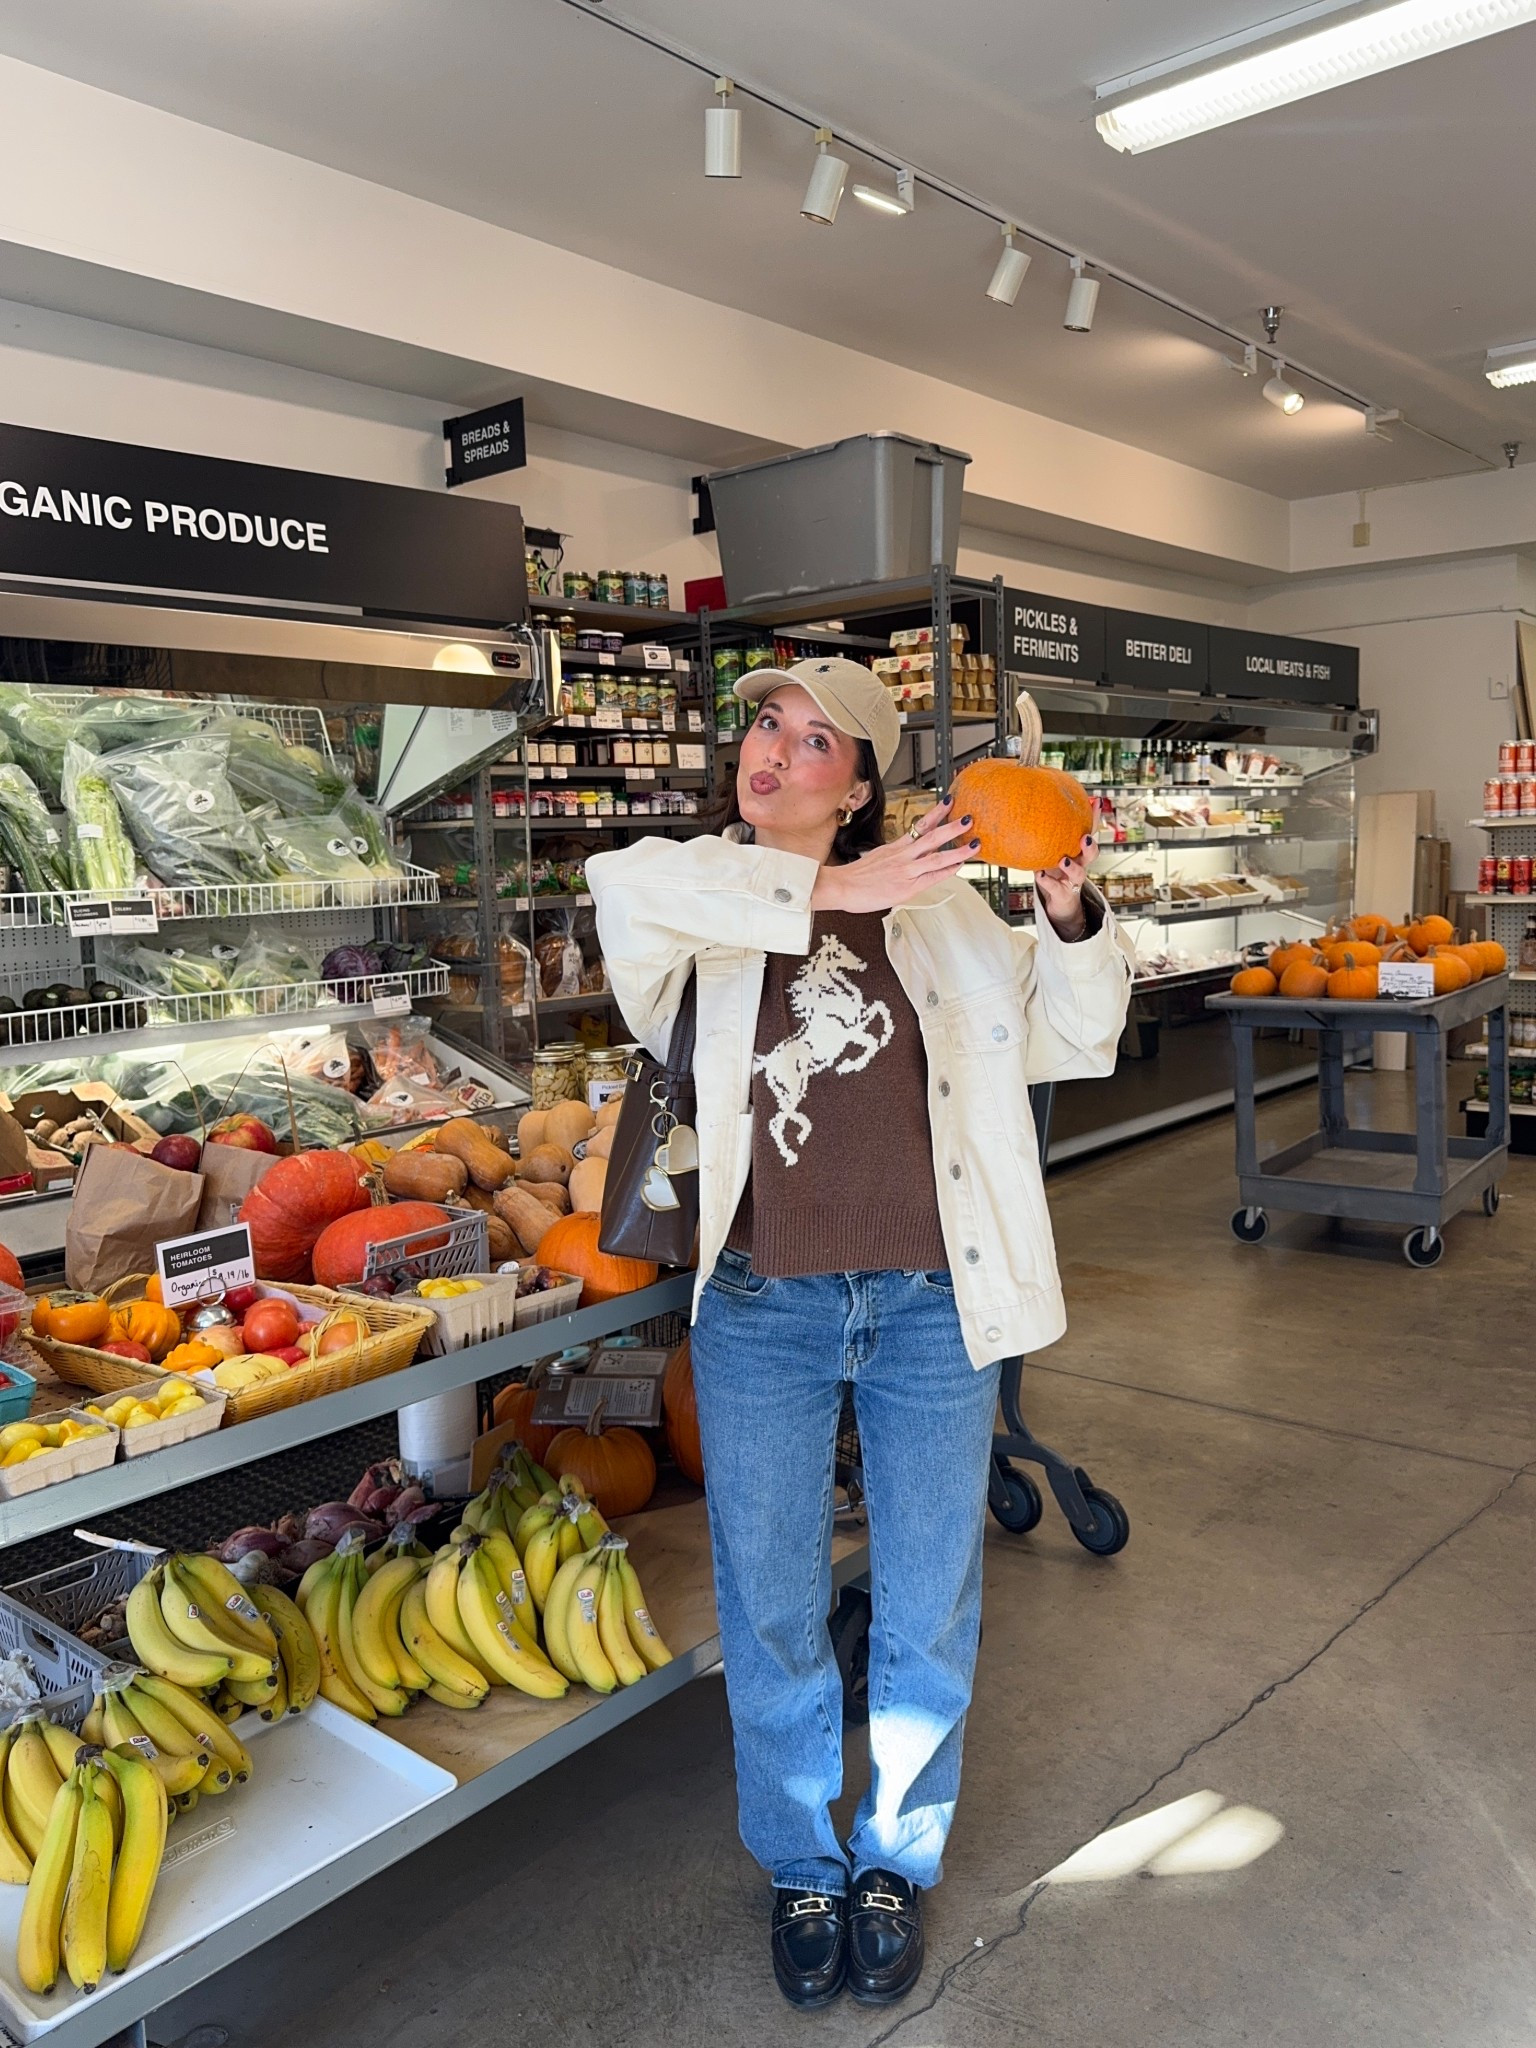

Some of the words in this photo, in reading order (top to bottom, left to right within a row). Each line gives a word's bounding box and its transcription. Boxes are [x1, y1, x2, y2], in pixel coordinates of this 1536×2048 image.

[461, 423, 501, 446] BREADS
[503, 420, 510, 434] &
[464, 439, 509, 463] SPREADS
[0, 481, 133, 529] GANIC
[144, 500, 330, 553] PRODUCE
[1014, 606, 1067, 634] PICKLES
[1069, 617, 1078, 636] &
[1013, 635, 1079, 663] FERMENTS
[1125, 639, 1168, 661] BETTER
[1168, 645, 1192, 664] DELI
[1246, 656, 1276, 674] LOCAL
[1276, 659, 1304, 678] MEATS
[1305, 663, 1312, 678] &
[1313, 664, 1331, 680] FISH
[470, 1092, 491, 1109] Pita
[170, 1245, 211, 1262] HEIRLOOM
[171, 1253, 213, 1270] TOMATOES
